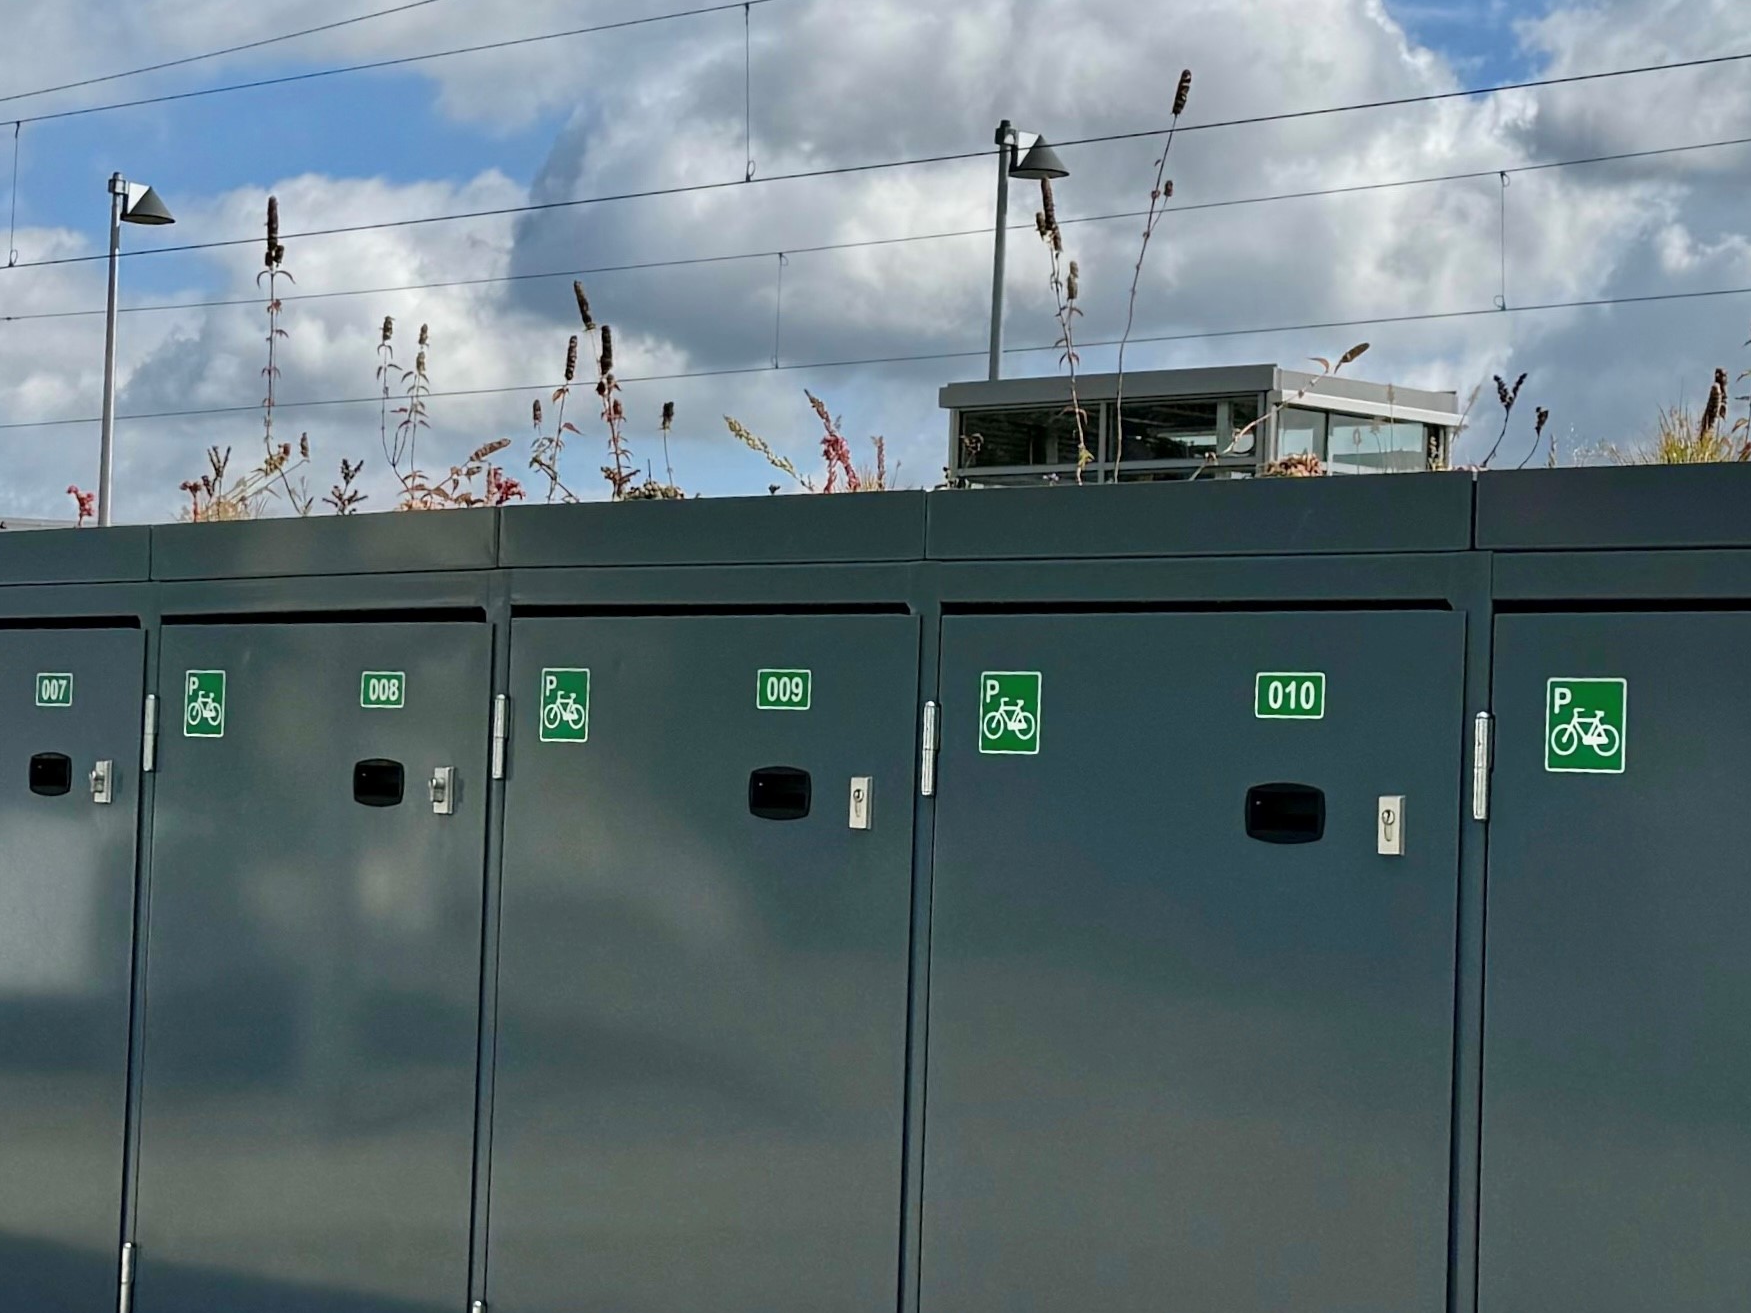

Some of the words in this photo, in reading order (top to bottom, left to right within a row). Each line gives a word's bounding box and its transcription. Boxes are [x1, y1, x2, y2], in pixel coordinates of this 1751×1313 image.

[41, 679, 68, 700] 007
[189, 677, 199, 695] P
[369, 678, 399, 701] 008
[546, 676, 557, 696] P
[767, 677, 803, 702] 009
[986, 680, 999, 703] P
[1269, 681, 1315, 709] 010
[1554, 688, 1572, 714] P
